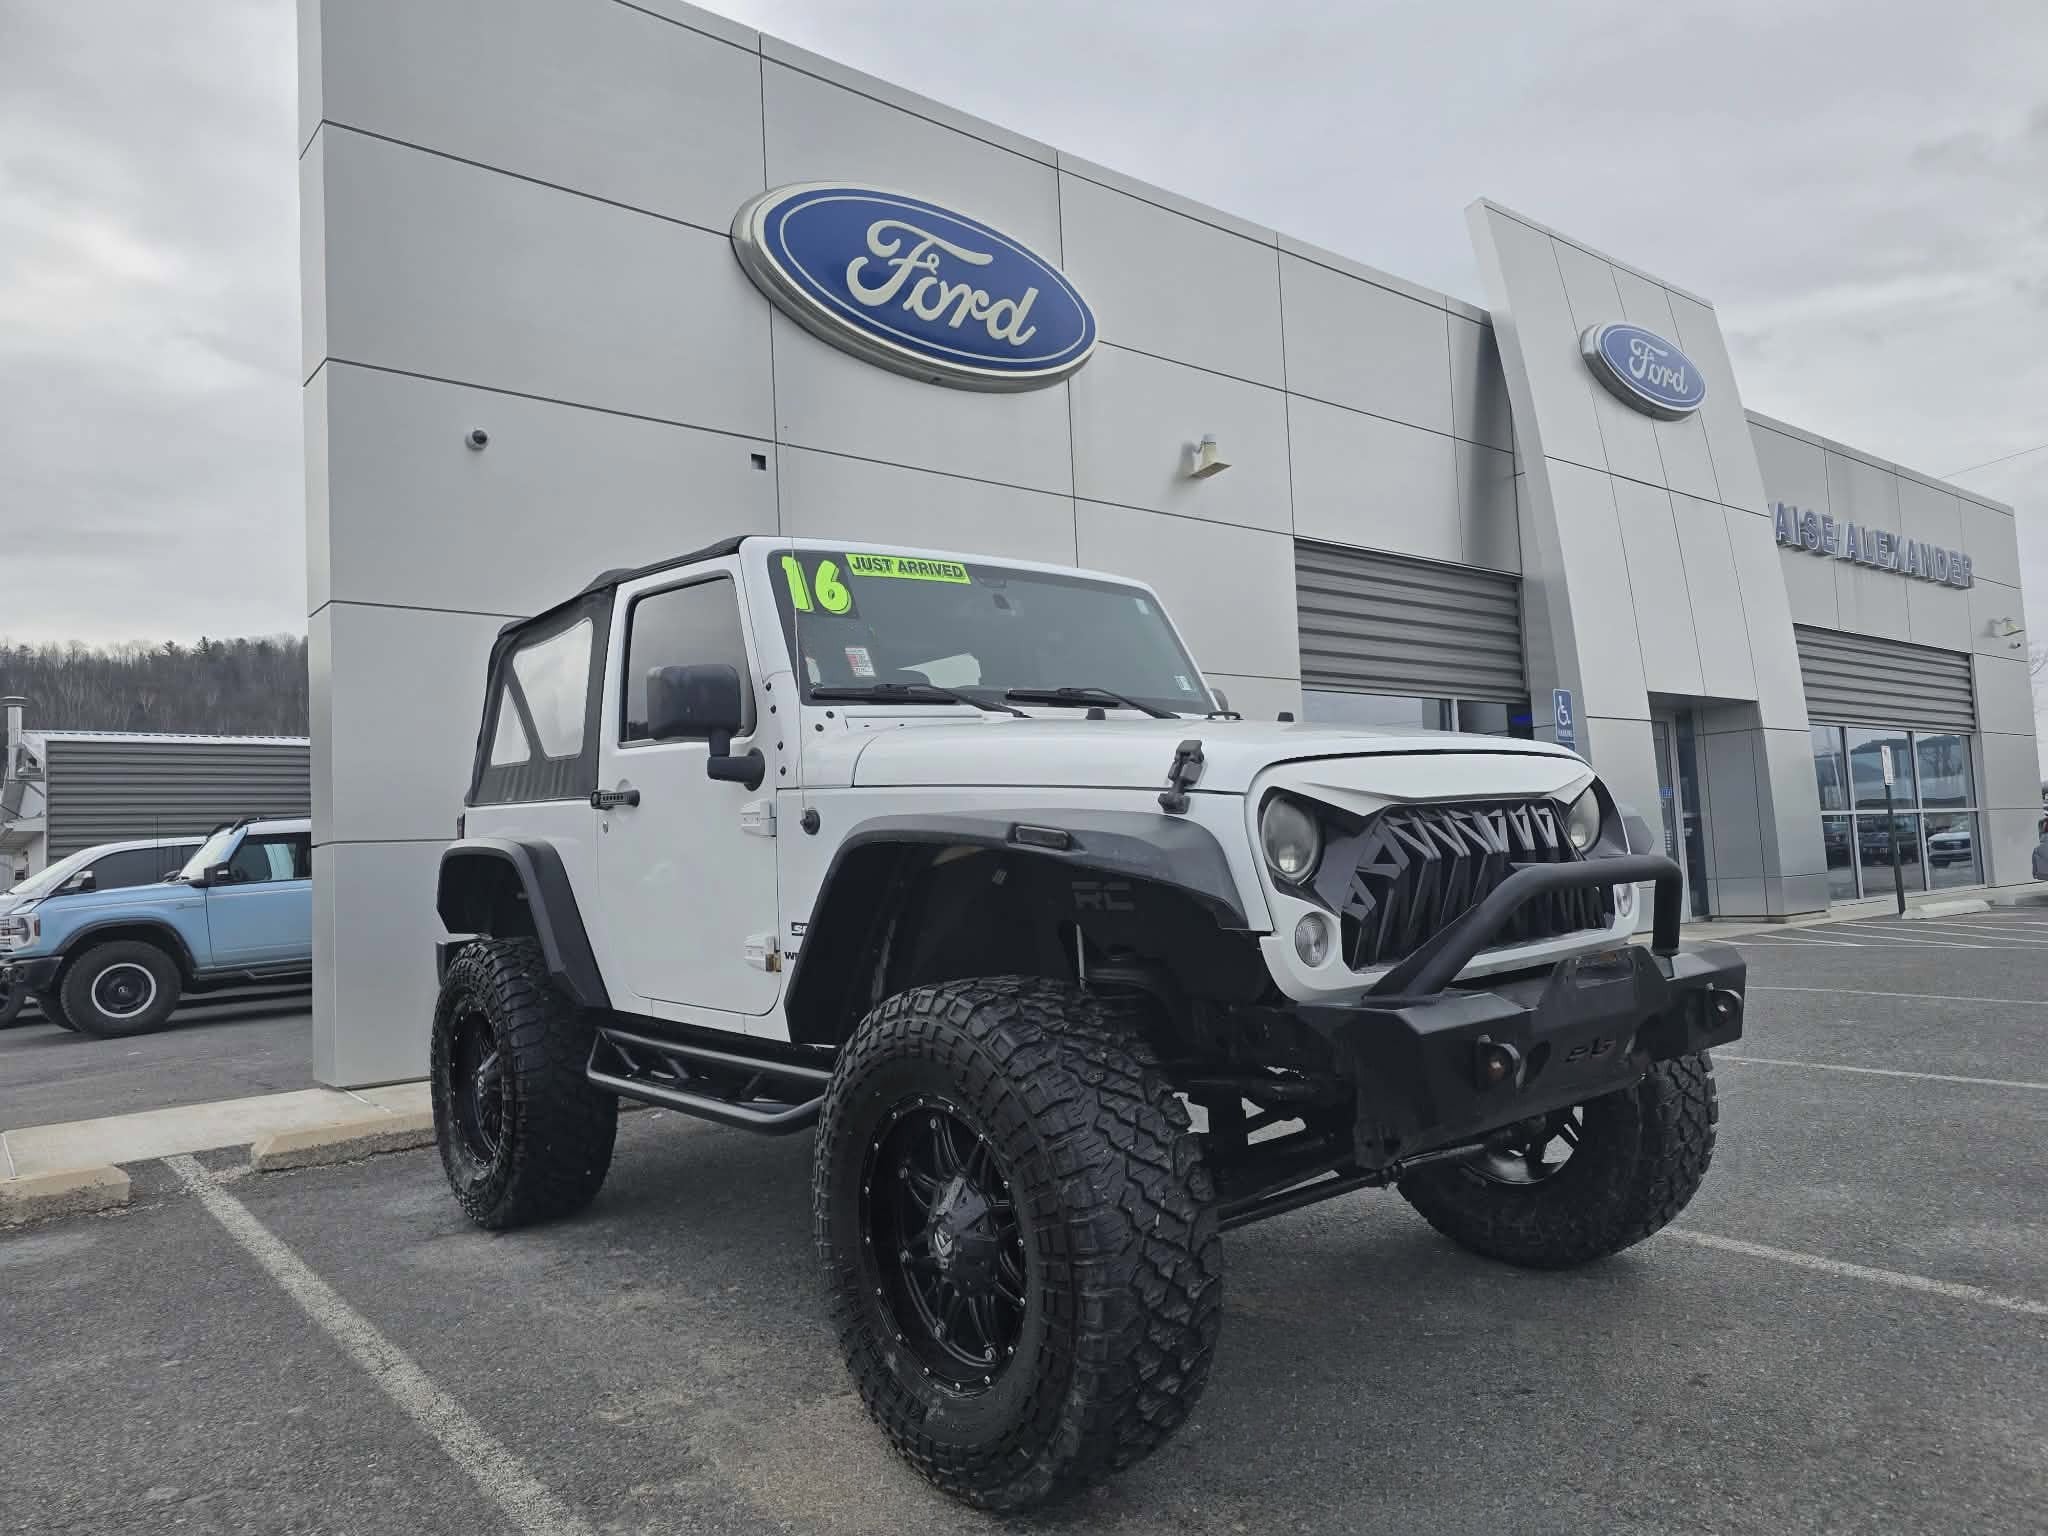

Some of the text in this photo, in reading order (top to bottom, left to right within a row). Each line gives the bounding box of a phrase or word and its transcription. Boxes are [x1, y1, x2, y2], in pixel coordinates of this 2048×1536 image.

[846, 219, 1040, 346] Ford
[1629, 338, 1689, 395] Ford
[781, 555, 852, 615] 16
[852, 556, 964, 578] JUST ARRIVED
[1838, 521, 1974, 589] ALEXANDER
